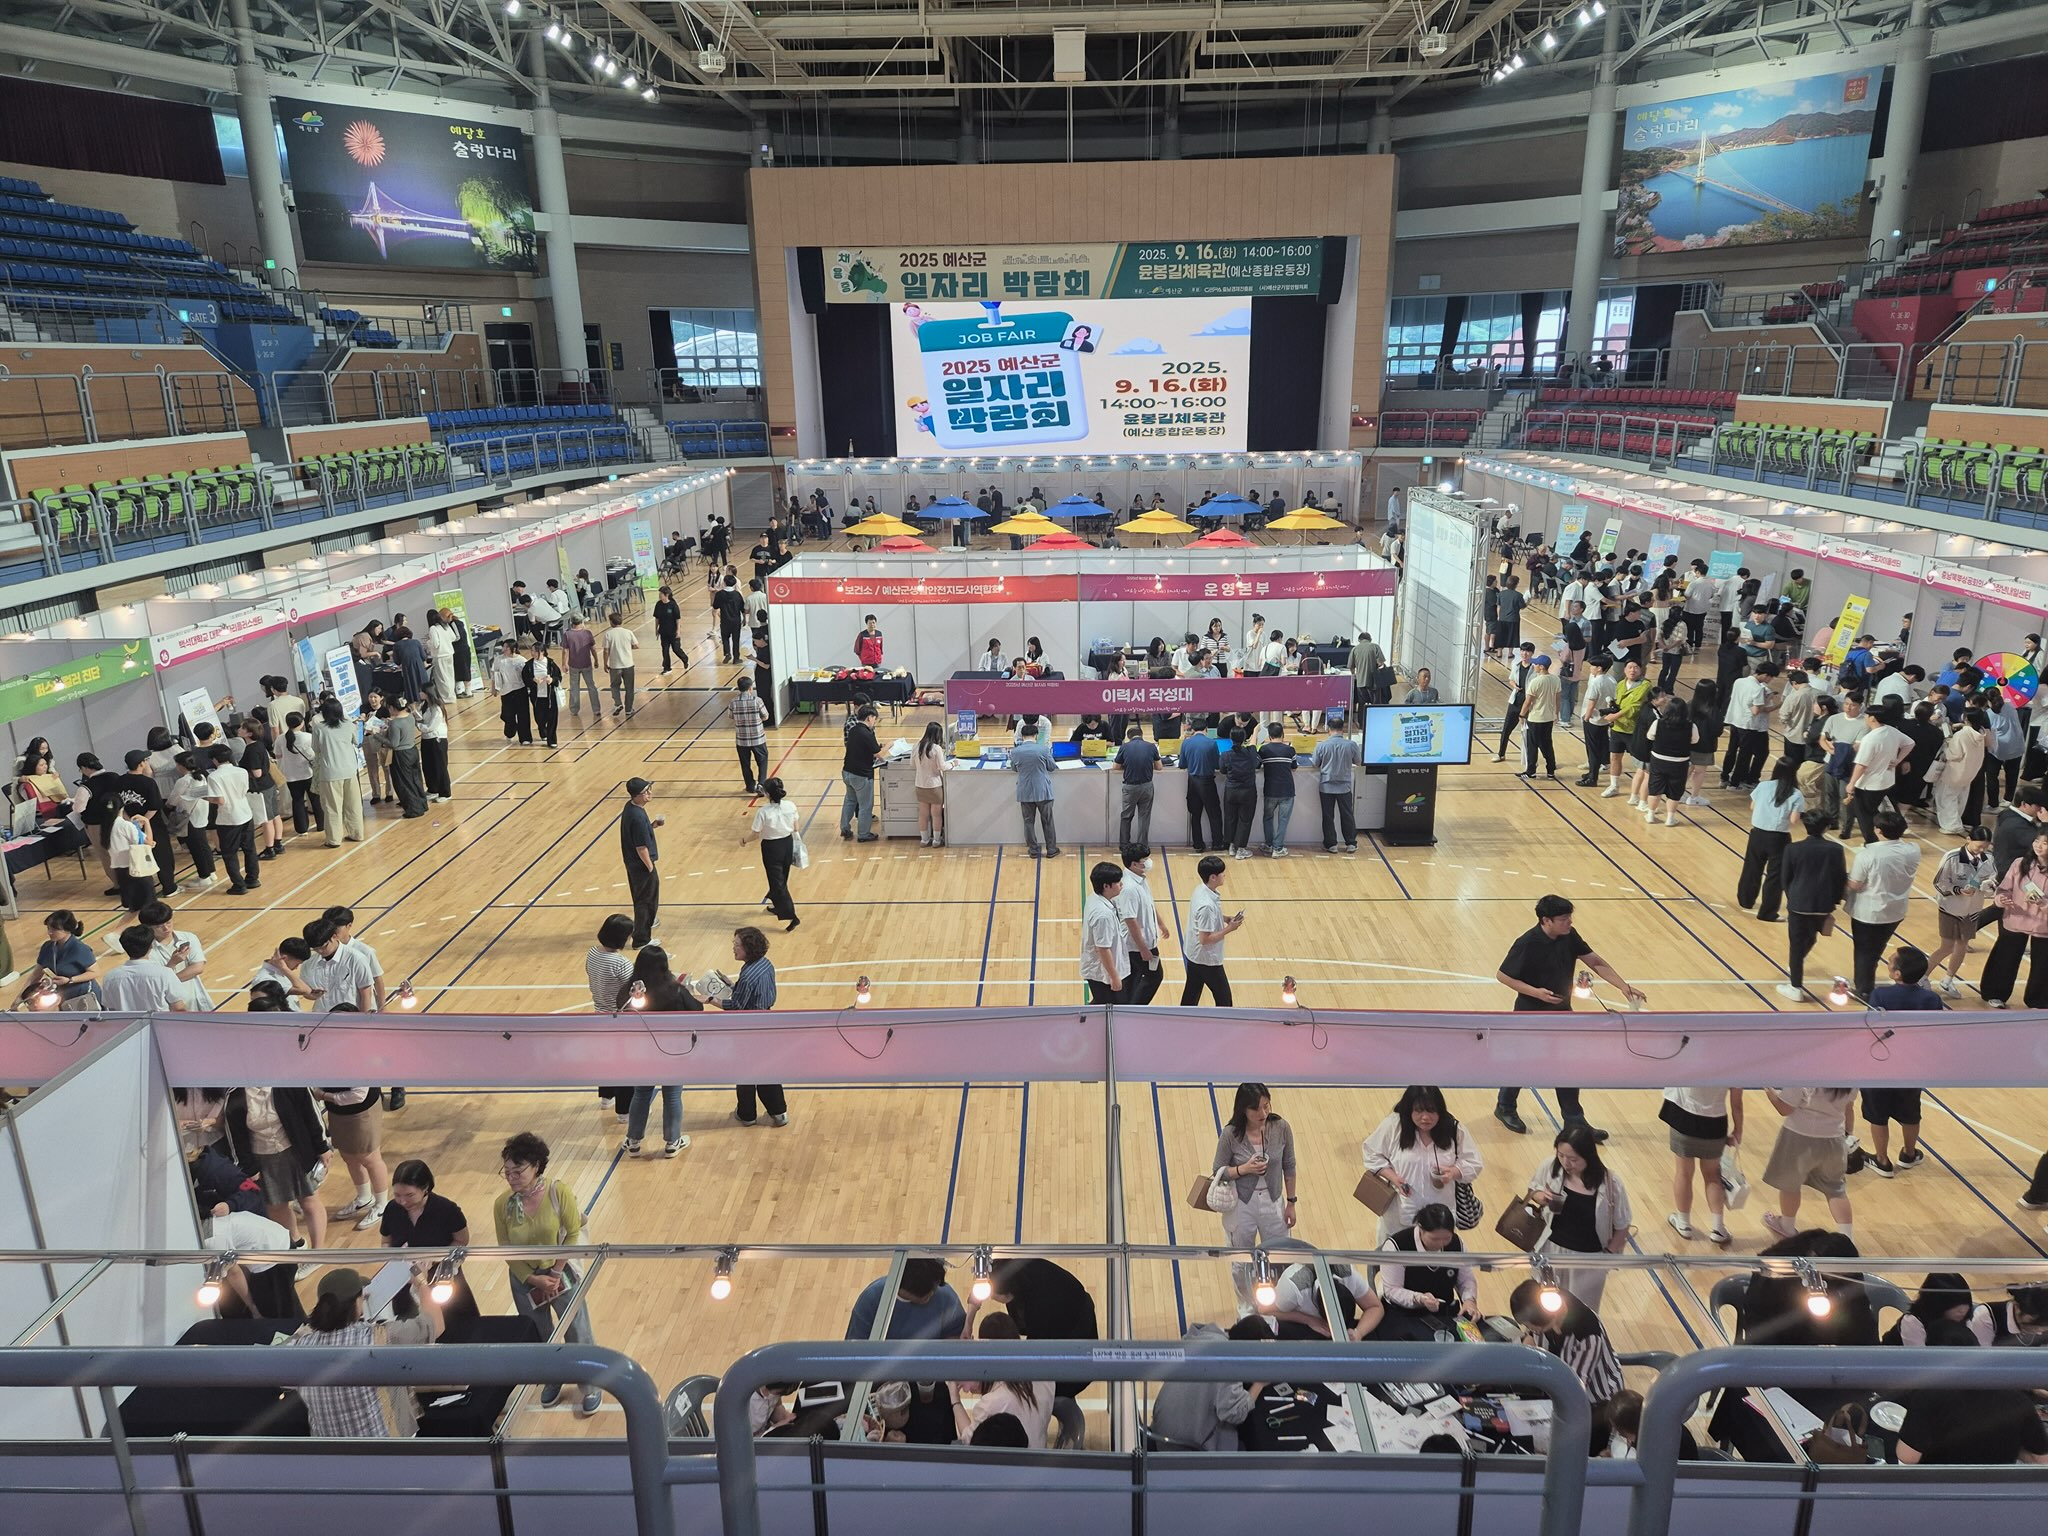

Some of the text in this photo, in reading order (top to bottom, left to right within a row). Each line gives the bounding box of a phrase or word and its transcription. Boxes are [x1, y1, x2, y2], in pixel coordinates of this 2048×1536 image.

[450, 126, 486, 140] 예당호
[452, 140, 517, 161] 출렁다리
[900, 252, 986, 268] 2025 예산군
[1138, 244, 1312, 260] 2025. 9. 16.(화) 14:00~16:00
[1138, 262, 1310, 280] 윤봉길체육관(예산종합운동장)
[900, 270, 1090, 299] 일자리 박람회
[189, 312, 207, 323] GATE
[208, 304, 217, 324] 3
[958, 330, 1036, 345] JOB FAIR
[942, 354, 1061, 376] 2025 예산군
[1162, 362, 1227, 375] 2025.
[942, 370, 1066, 405] 일자리
[1115, 377, 1227, 393] 9. 16.(화)
[1100, 396, 1226, 410] 14:00~16:00
[947, 401, 1071, 434] 박람회
[1124, 412, 1226, 425] 윤봉길체육관
[1122, 426, 1226, 437] (예산종합운동장)
[845, 586, 873, 595] 보건소
[1990, 582, 2032, 600] 장년내일센터
[161, 651, 168, 662] 16
[82, 666, 101, 683] 진단
[1102, 687, 1193, 702] 이력서 작성대
[1404, 729, 1427, 737] 일자리
[1405, 736, 1428, 744] 박람회
